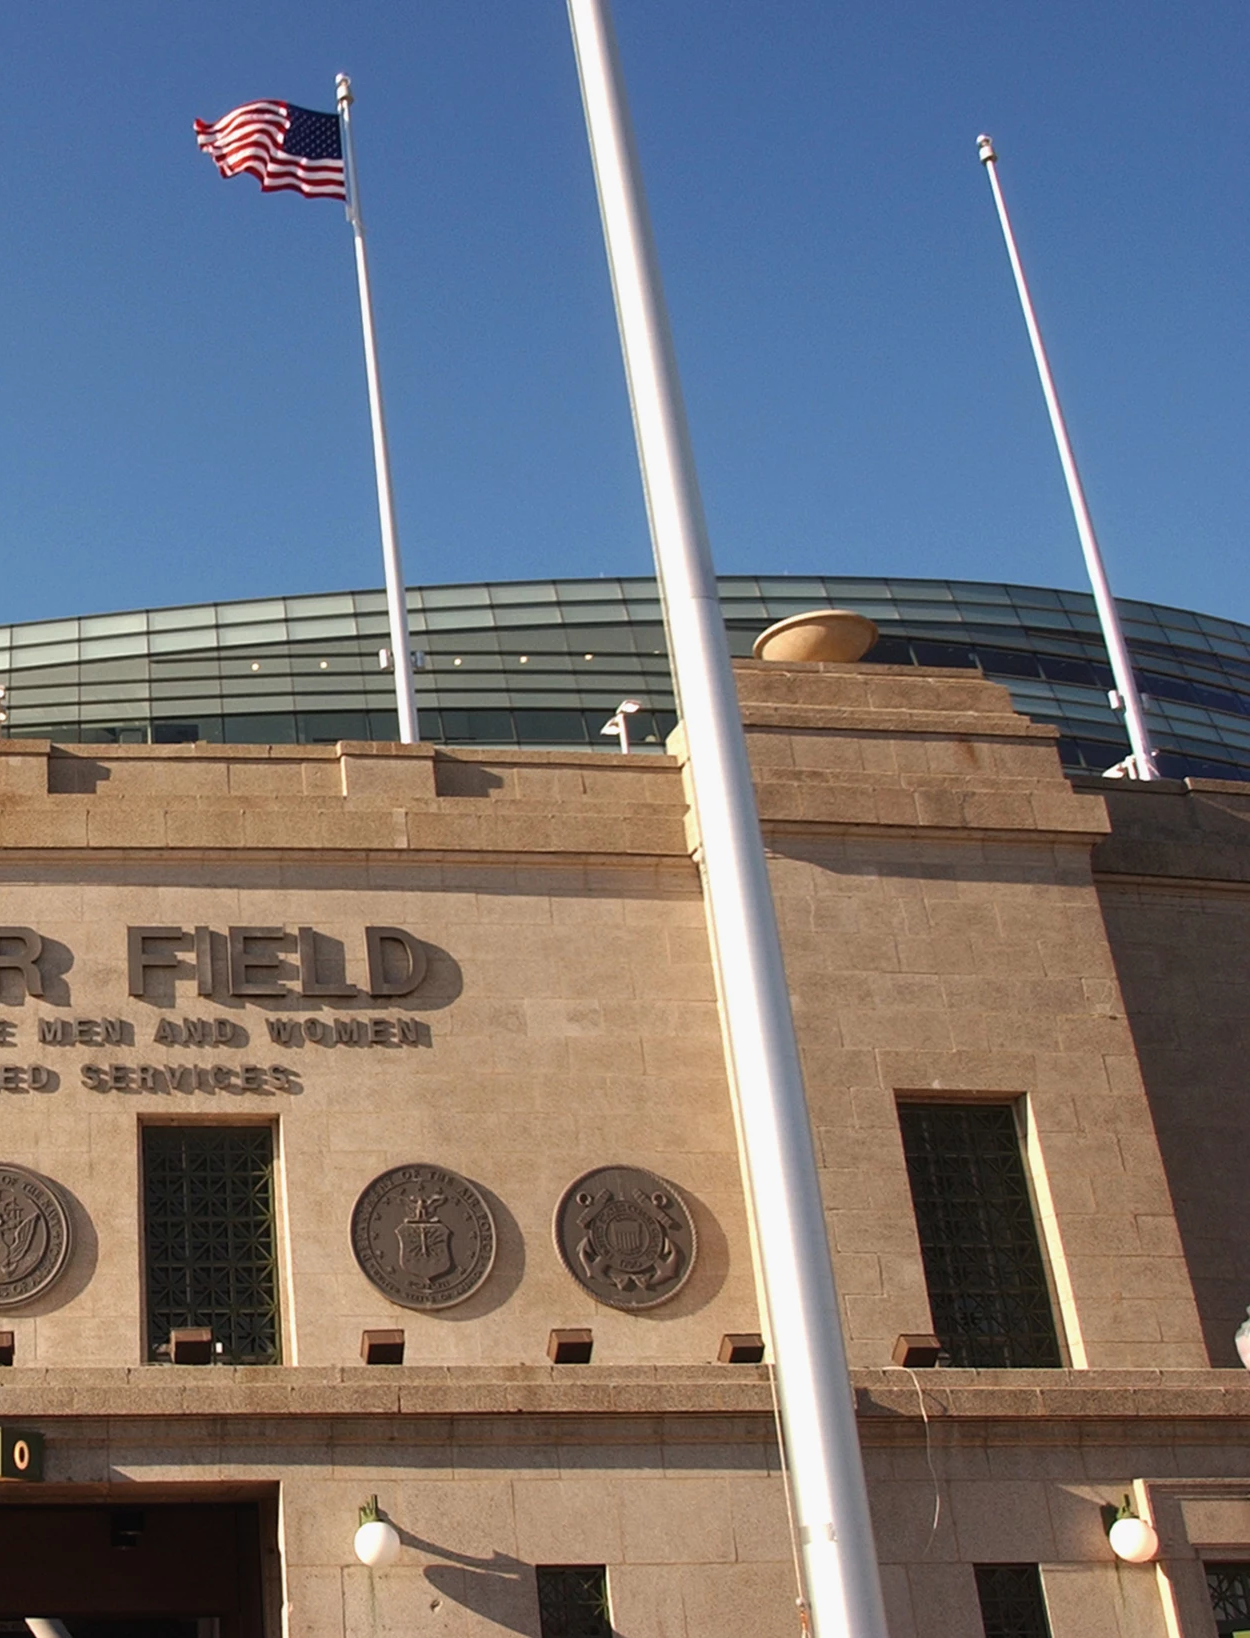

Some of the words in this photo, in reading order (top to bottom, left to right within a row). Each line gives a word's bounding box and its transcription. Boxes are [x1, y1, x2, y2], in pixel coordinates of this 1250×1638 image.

[126, 925, 429, 998] FIELD
[38, 1017, 125, 1043] MEN
[153, 1017, 237, 1044] AND
[266, 1017, 421, 1045] WOMEN
[80, 1063, 290, 1091] SERVICES
